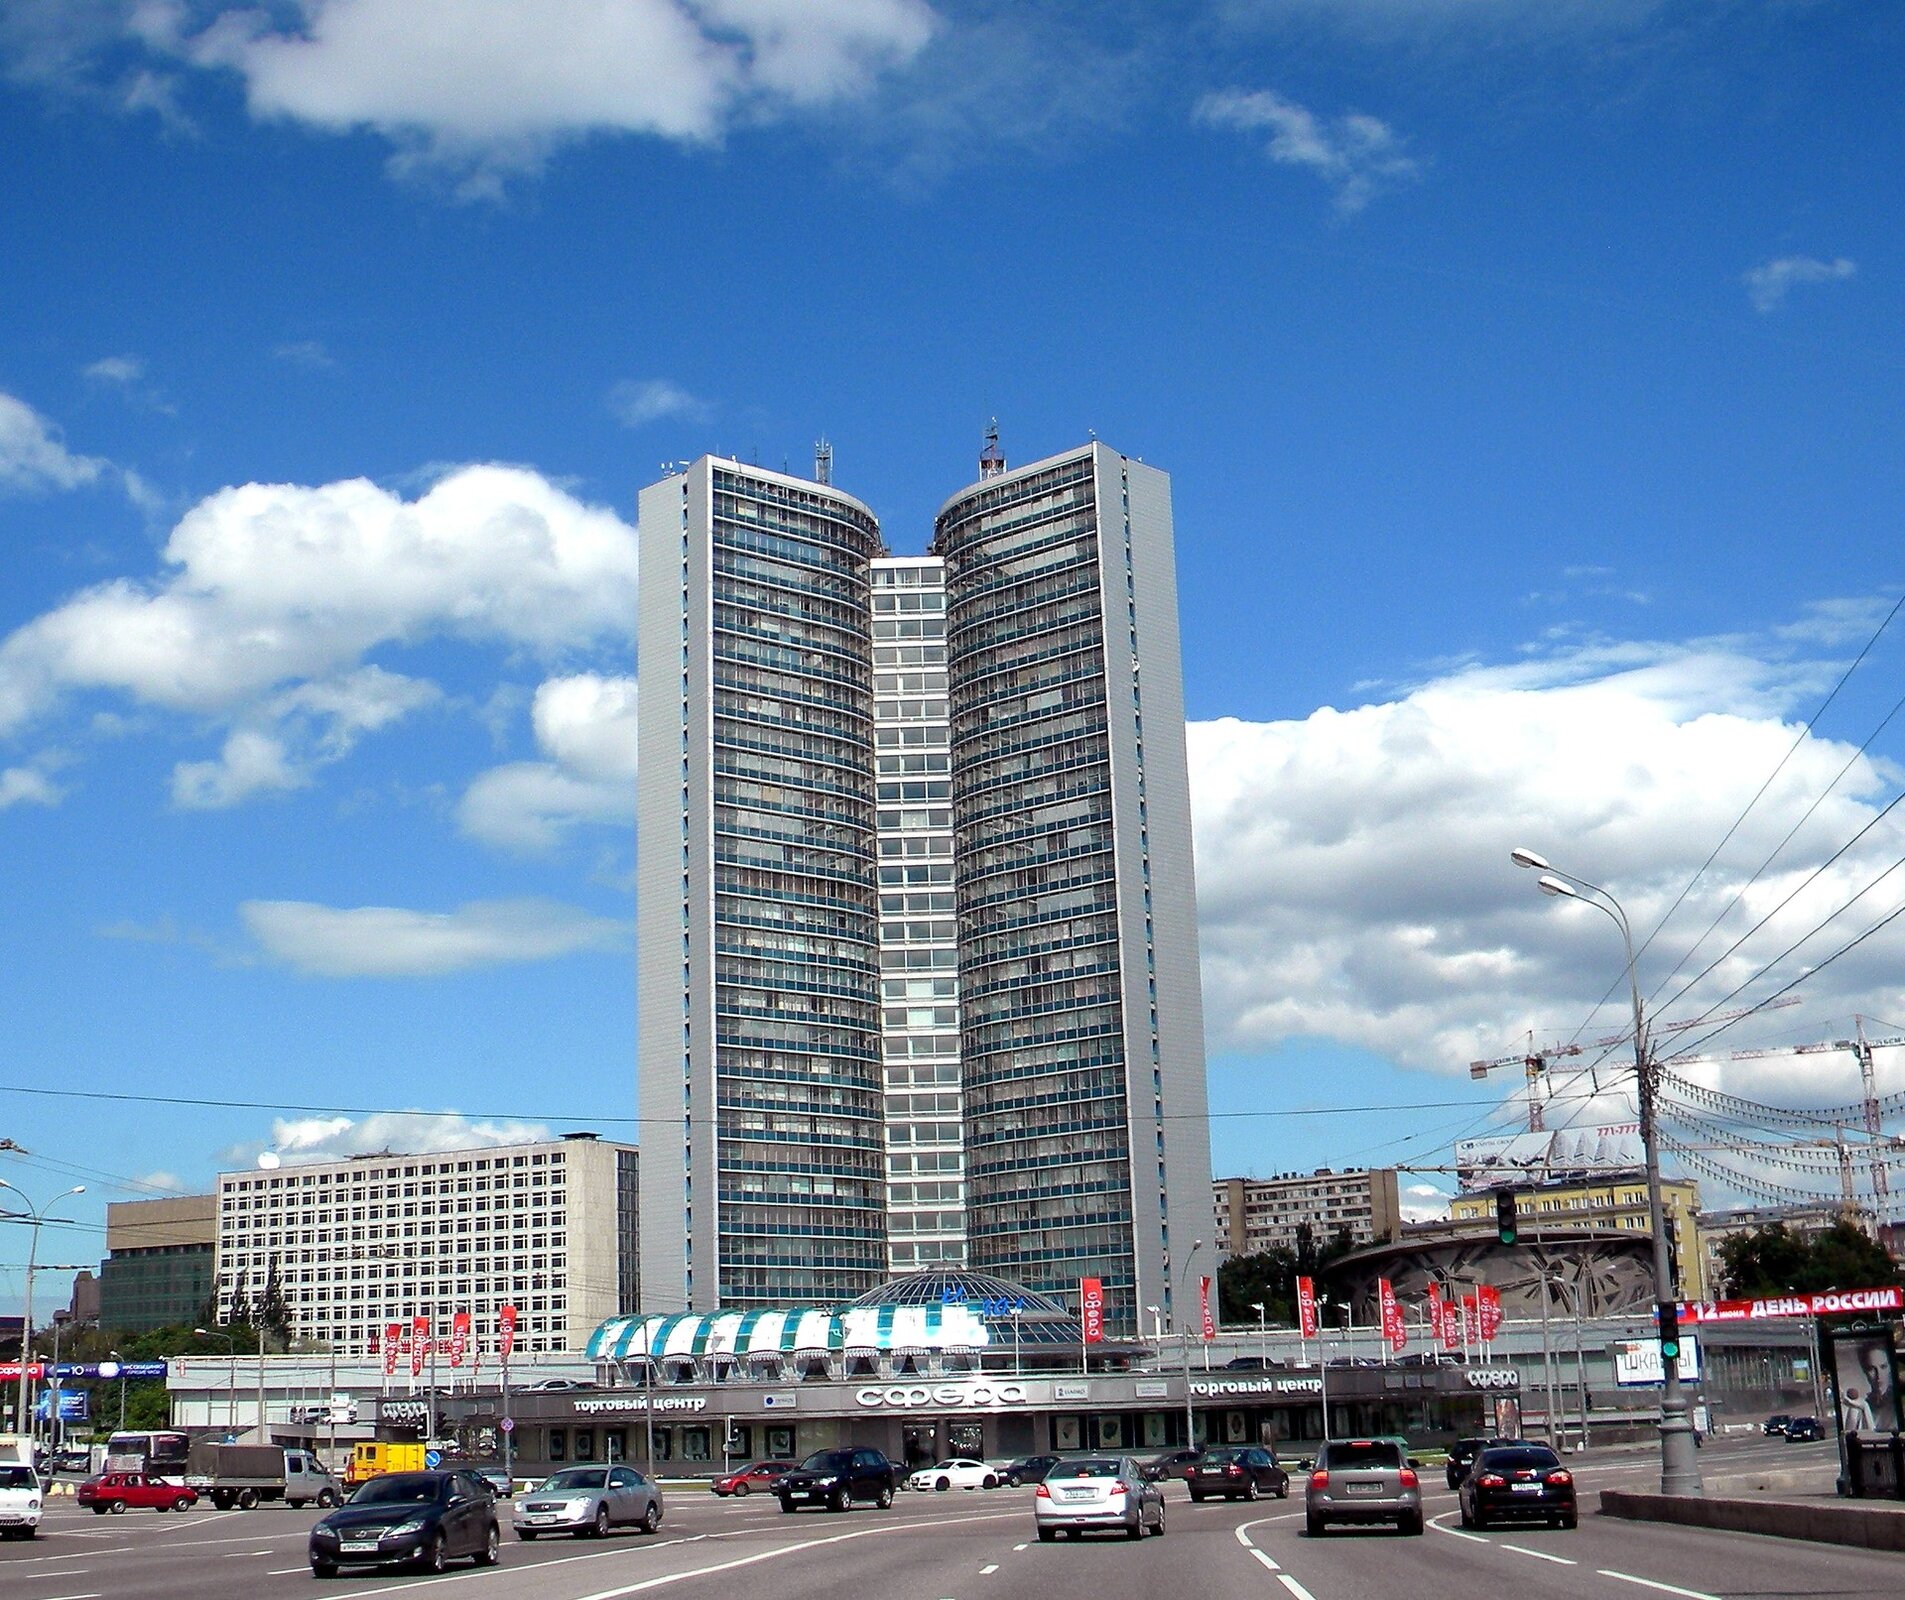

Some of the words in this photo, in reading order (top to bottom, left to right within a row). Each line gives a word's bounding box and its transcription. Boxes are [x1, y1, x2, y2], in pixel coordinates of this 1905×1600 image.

[1085, 1291, 1102, 1336] сфера
[1691, 1301, 1719, 1320] 12
[1750, 1299, 1808, 1318] ДЕНЬ
[1811, 1289, 1896, 1312] РОССИИ
[71, 1365, 84, 1376] 10
[1623, 1350, 1691, 1371] ШКАЫ
[1188, 1377, 1272, 1397] торговый
[1276, 1378, 1323, 1393] центр
[1467, 1369, 1519, 1389] сфера
[573, 1396, 648, 1414] торговый
[652, 1397, 706, 1412] центр
[855, 1384, 1027, 1408] сфера
